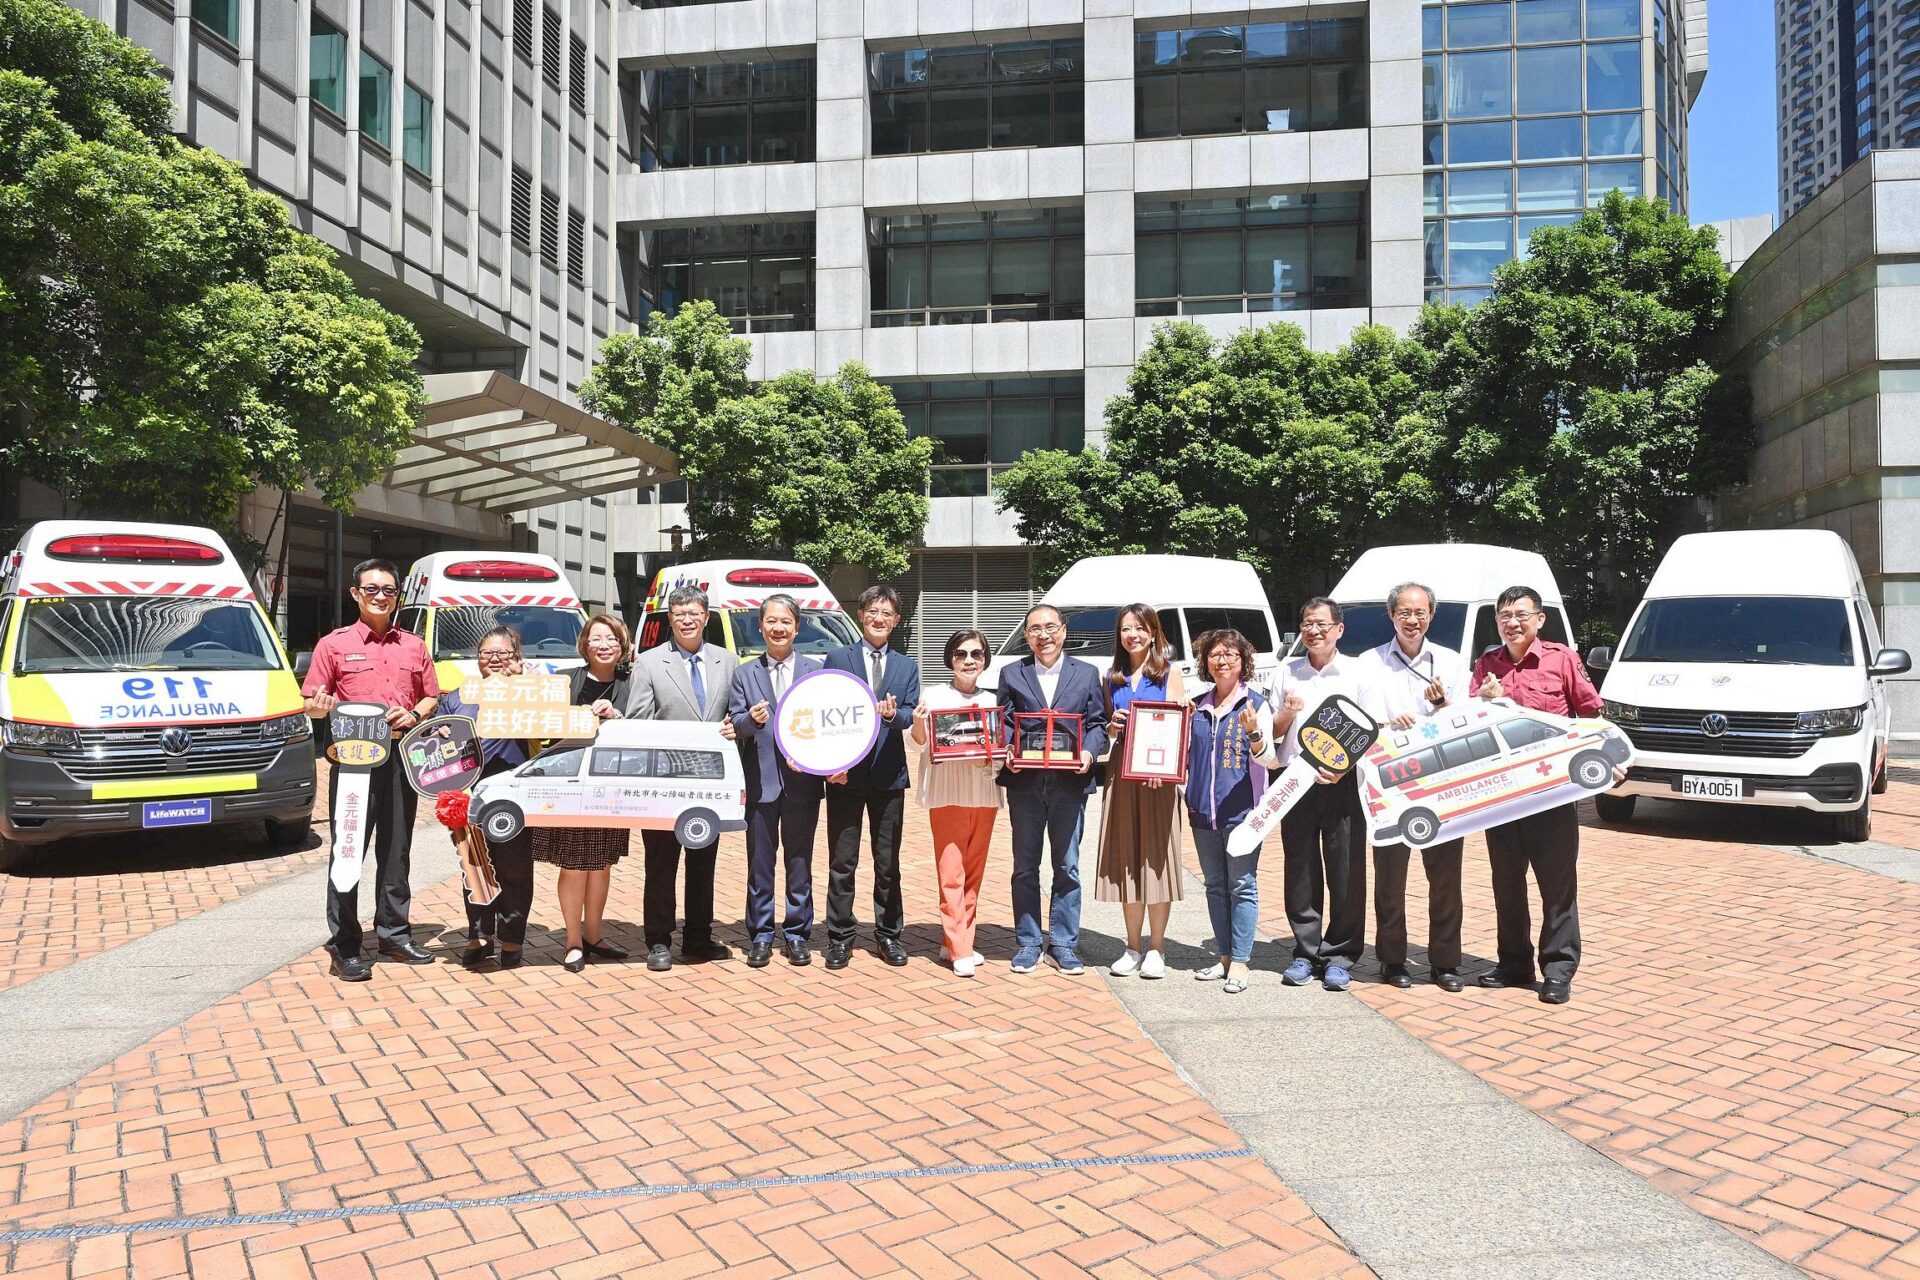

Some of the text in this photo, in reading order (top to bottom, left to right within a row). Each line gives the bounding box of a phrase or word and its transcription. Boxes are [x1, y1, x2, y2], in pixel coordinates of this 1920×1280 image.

[641, 621, 660, 647] 119
[464, 678, 566, 702] #金元福
[357, 717, 388, 740] 119
[821, 705, 865, 727] KYF
[1305, 730, 1345, 766] 救護車
[1335, 722, 1370, 753] 119
[331, 744, 380, 760] 救護車
[1386, 758, 1423, 783] 119
[1437, 773, 1509, 802] AMBULANCE
[149, 806, 206, 820] LifeWATCH
[1249, 778, 1299, 832] 金元福3號
[341, 792, 360, 859] 金元福5號
